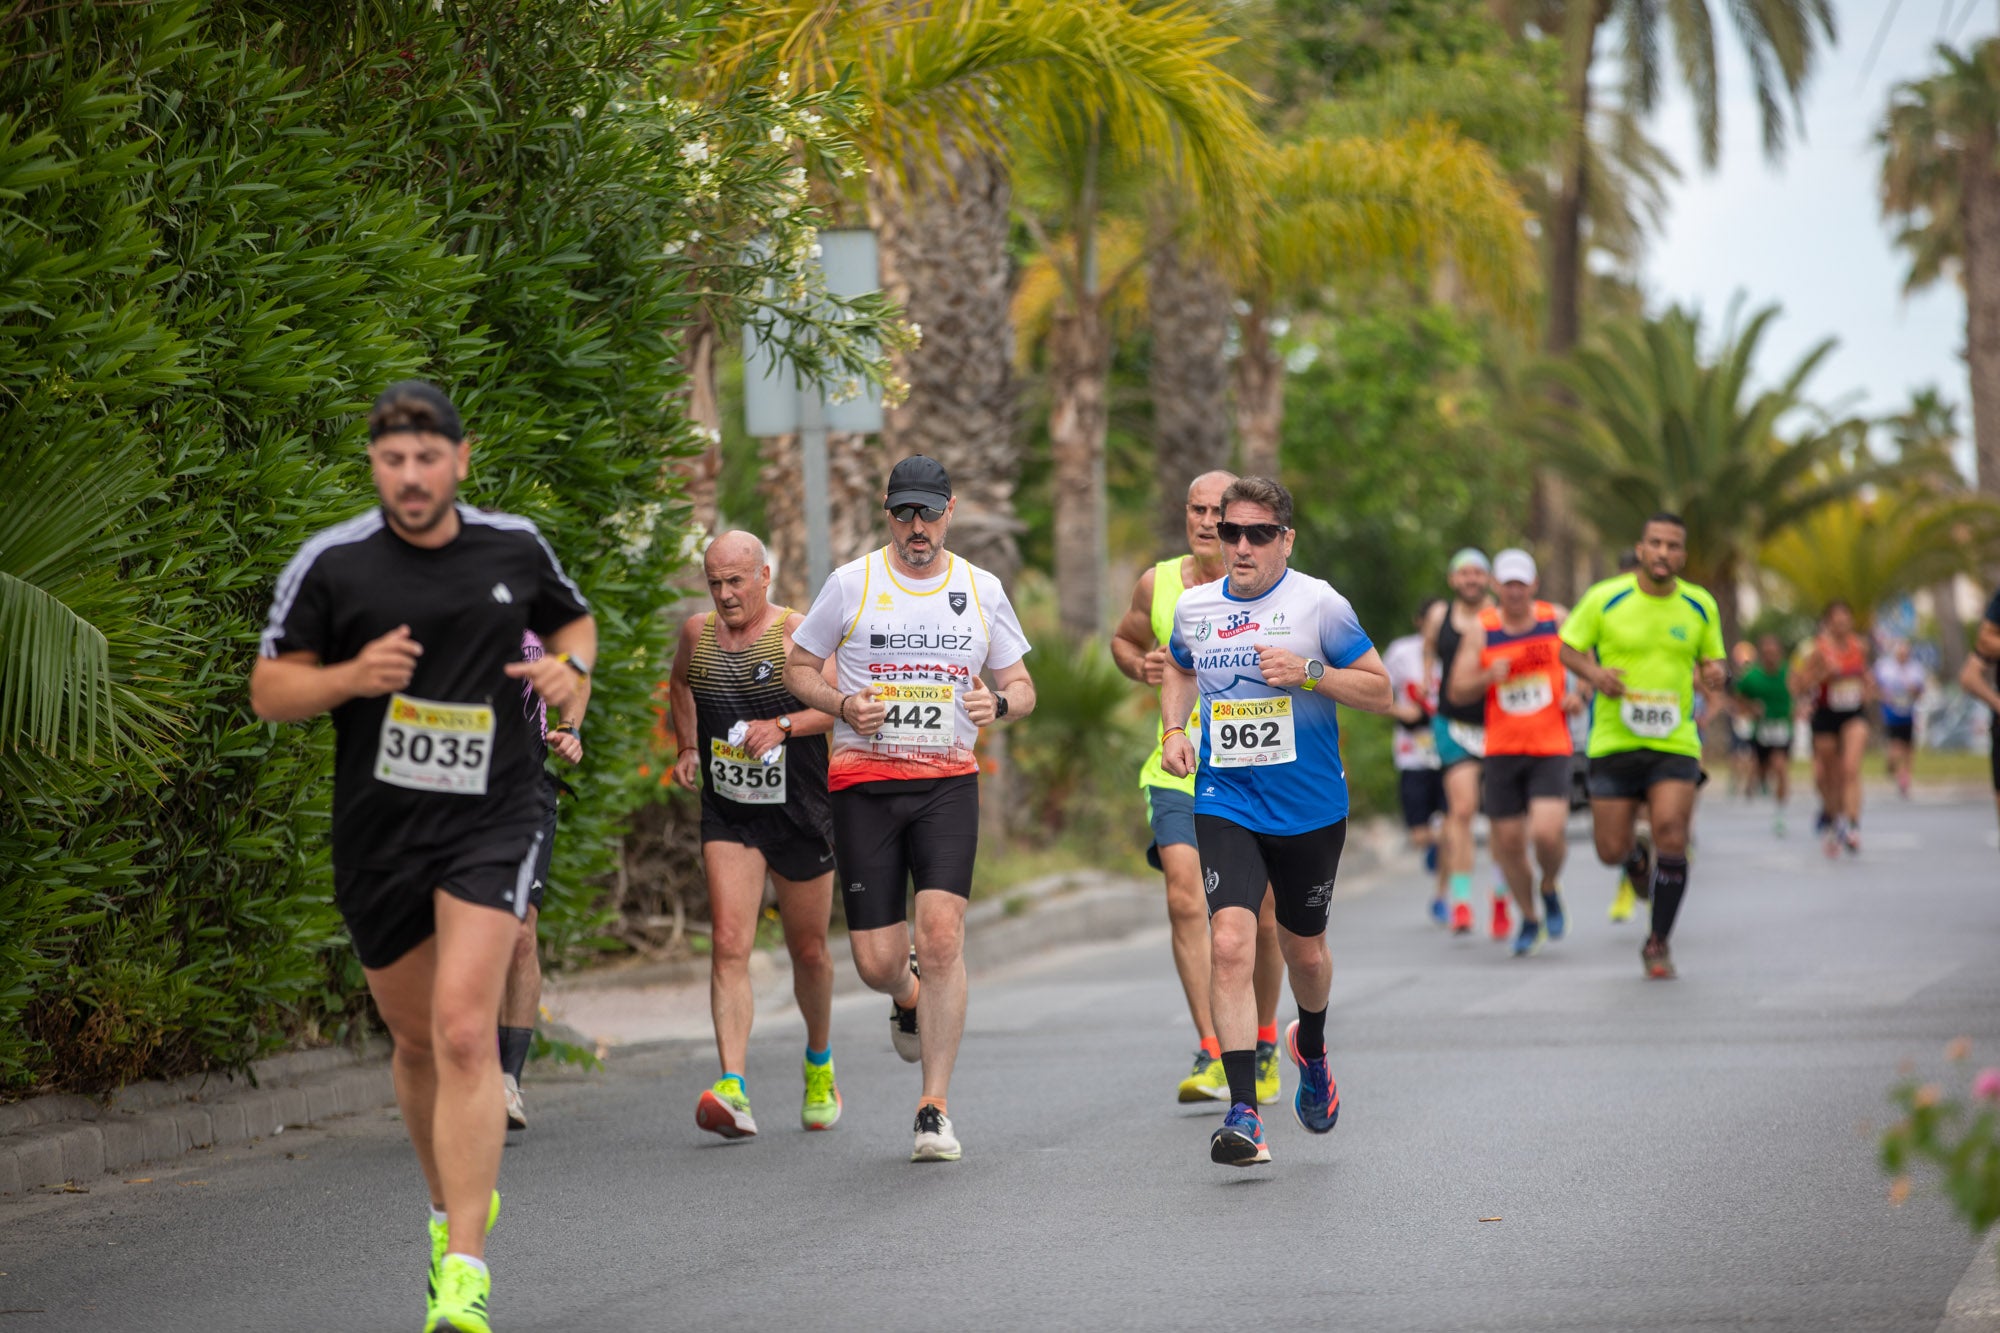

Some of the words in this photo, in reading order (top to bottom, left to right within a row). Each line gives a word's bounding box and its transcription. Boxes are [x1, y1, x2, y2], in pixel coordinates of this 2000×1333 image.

[1227, 611, 1250, 630] 35
[868, 663, 970, 677] GRANADA
[871, 672, 969, 685] RUNNERS
[883, 685, 897, 697] 38
[884, 704, 942, 730] 442
[1220, 704, 1232, 716] 38
[1220, 721, 1281, 750] 962
[386, 727, 484, 769] 3035
[714, 760, 782, 789] 3356
